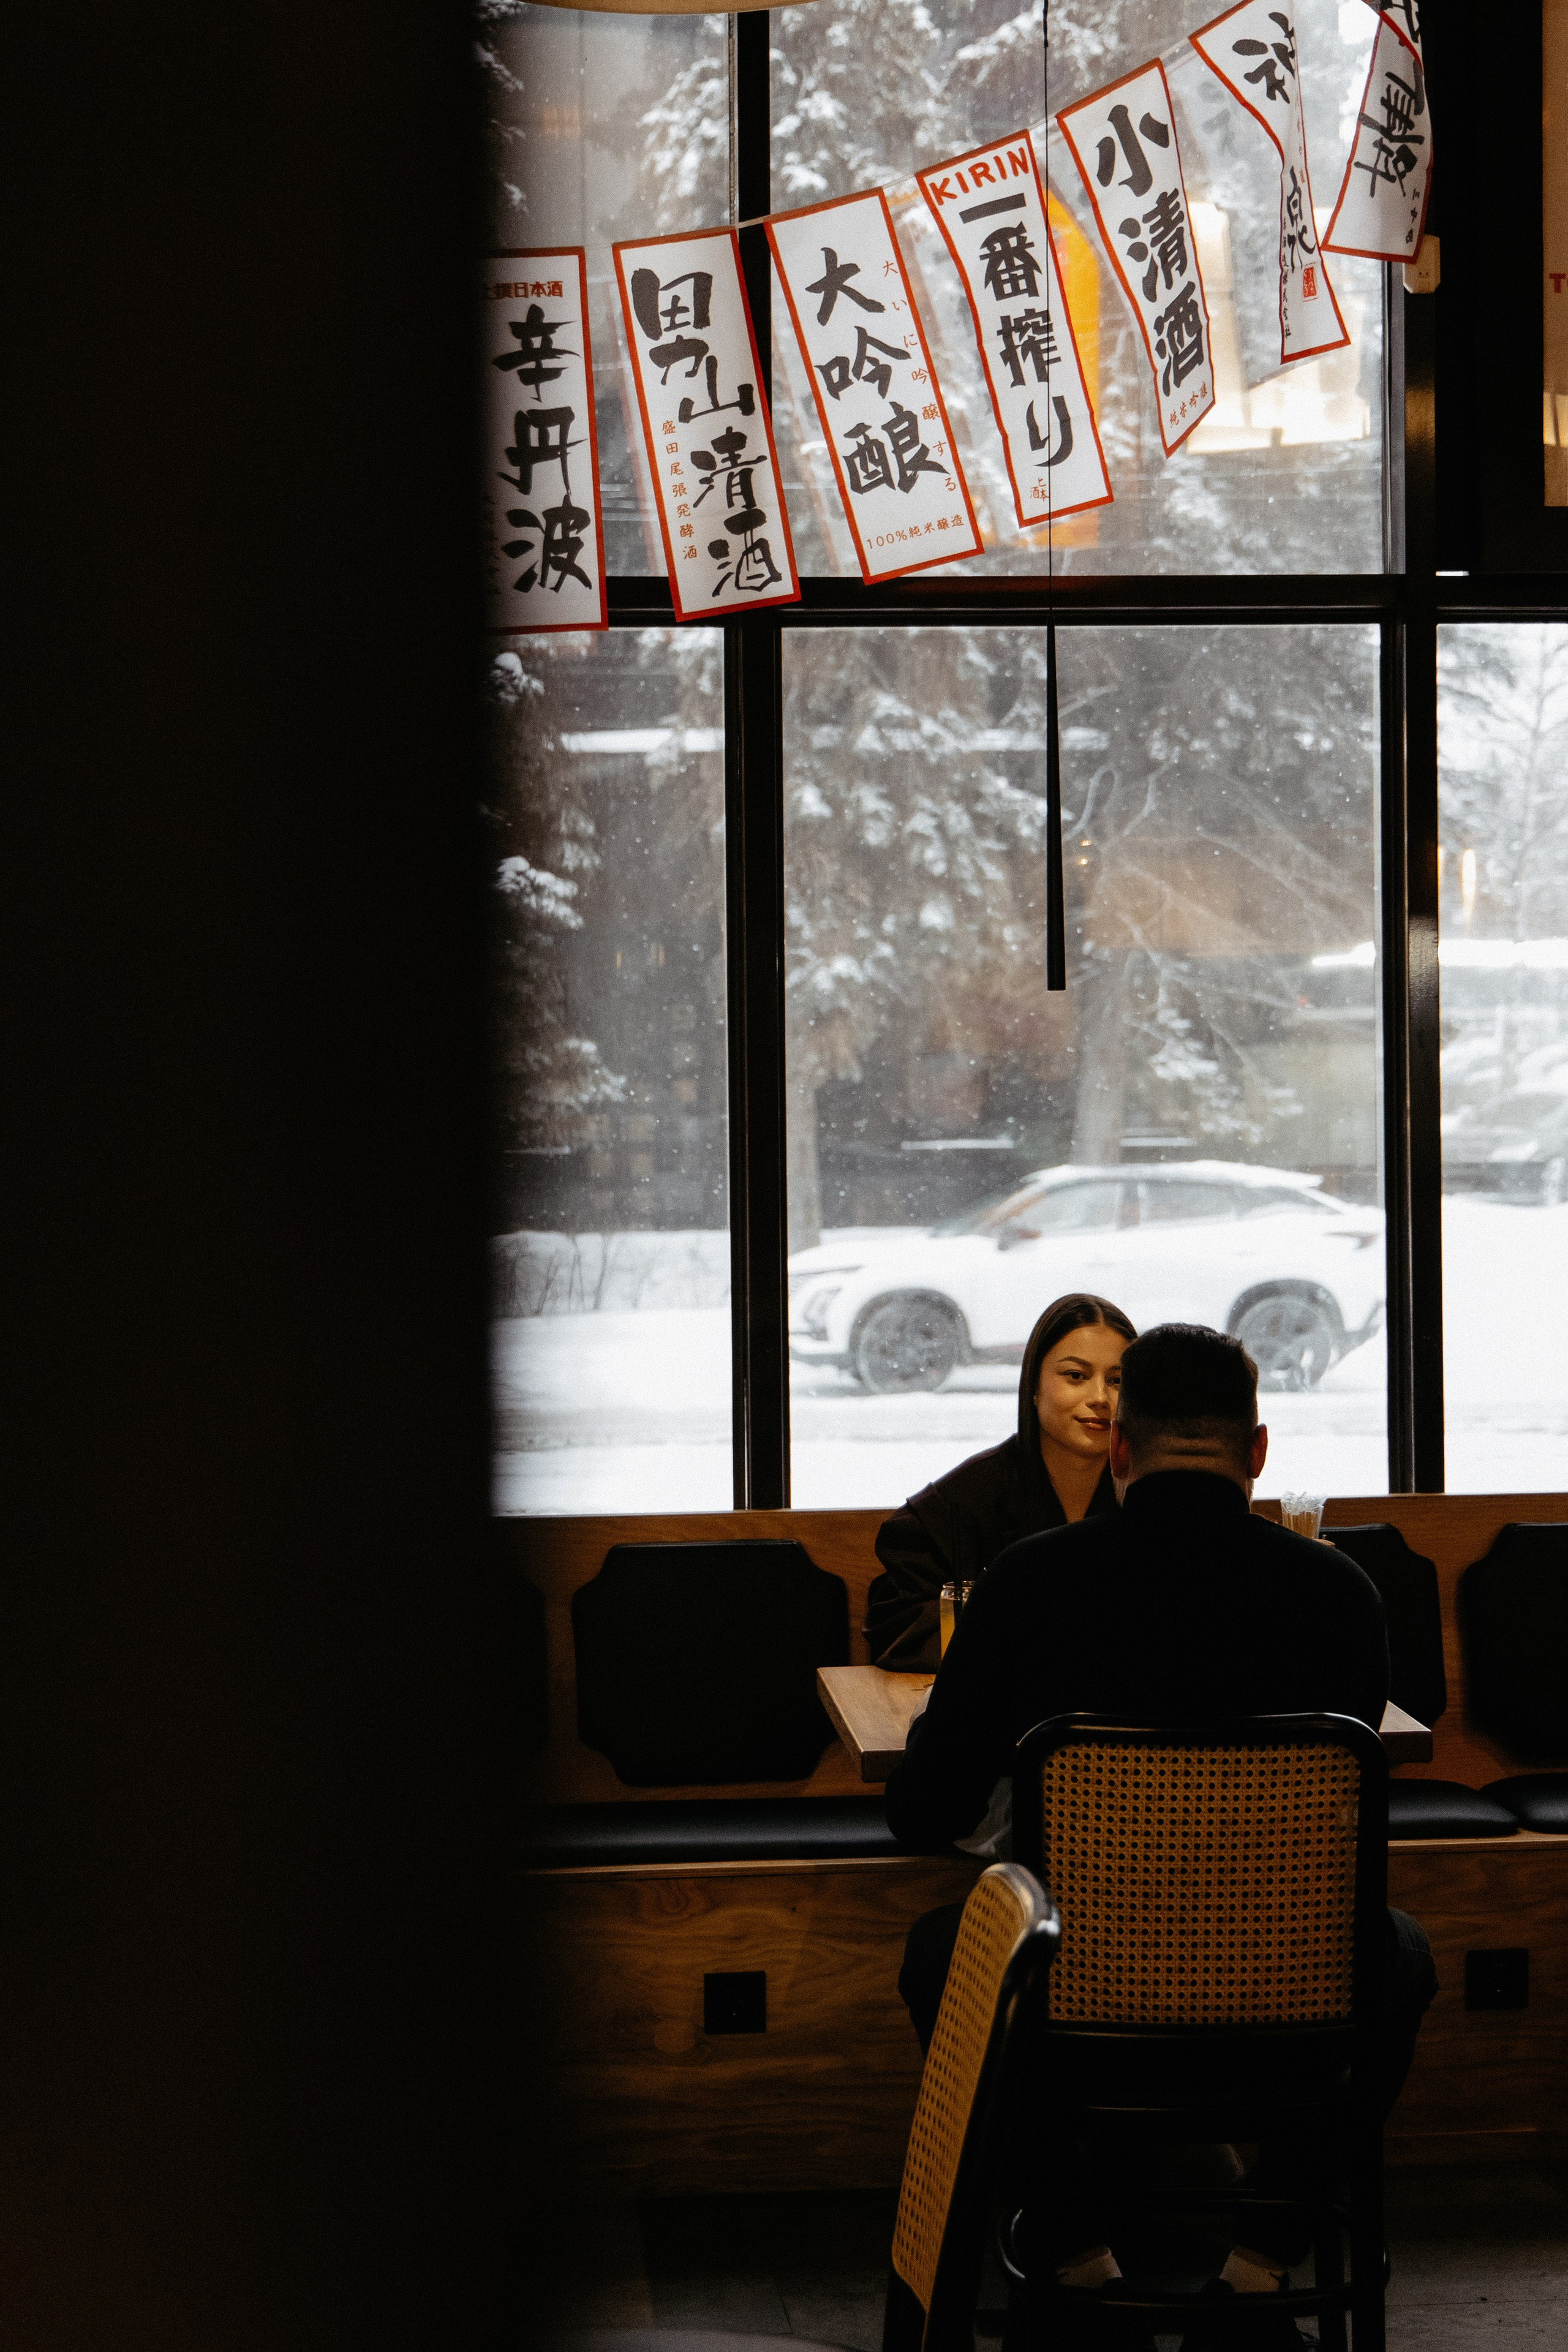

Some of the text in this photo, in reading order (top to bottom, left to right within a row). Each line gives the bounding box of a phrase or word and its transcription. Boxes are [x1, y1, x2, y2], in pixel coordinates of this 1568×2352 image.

[929, 146, 1029, 206] KIRIN
[1096, 104, 1205, 396] 小清酒
[959, 193, 1074, 467] 一番搾り
[1549, 273, 1568, 293] T
[492, 304, 592, 593] 辛丹波
[631, 268, 783, 597] 男山清酒
[662, 420, 698, 560] 盛田尾張発酵酒
[866, 514, 964, 549] 100%純米醸造
